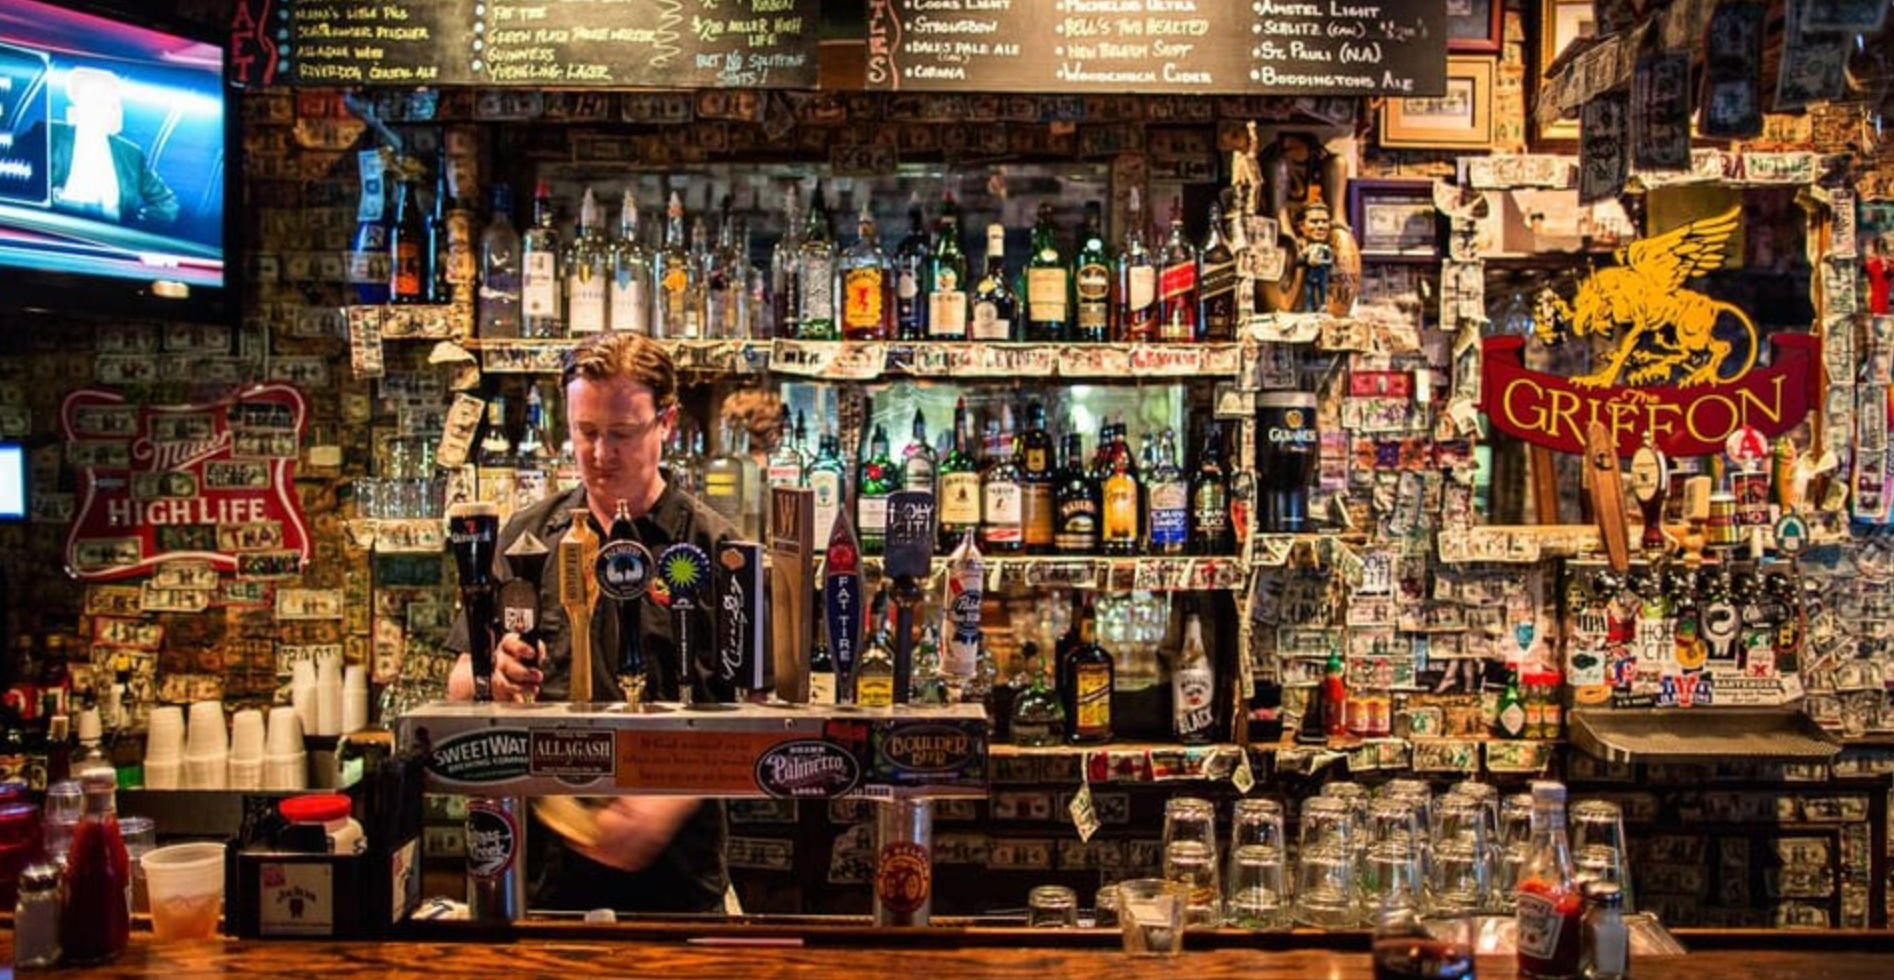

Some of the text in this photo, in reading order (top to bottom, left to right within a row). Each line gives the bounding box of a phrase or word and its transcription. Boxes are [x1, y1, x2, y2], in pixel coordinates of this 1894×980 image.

[1259, 0, 1381, 18] AMSTEL LIGHT
[993, 43, 1020, 56] ALE
[1381, 69, 1415, 91] ALE
[1502, 374, 1787, 448] GRIFFON
[107, 498, 266, 525] HIGH LIFE
[535, 739, 611, 758] ALLAGASH
[891, 735, 969, 756] BOULDER
[765, 753, 844, 785] Palmetto
